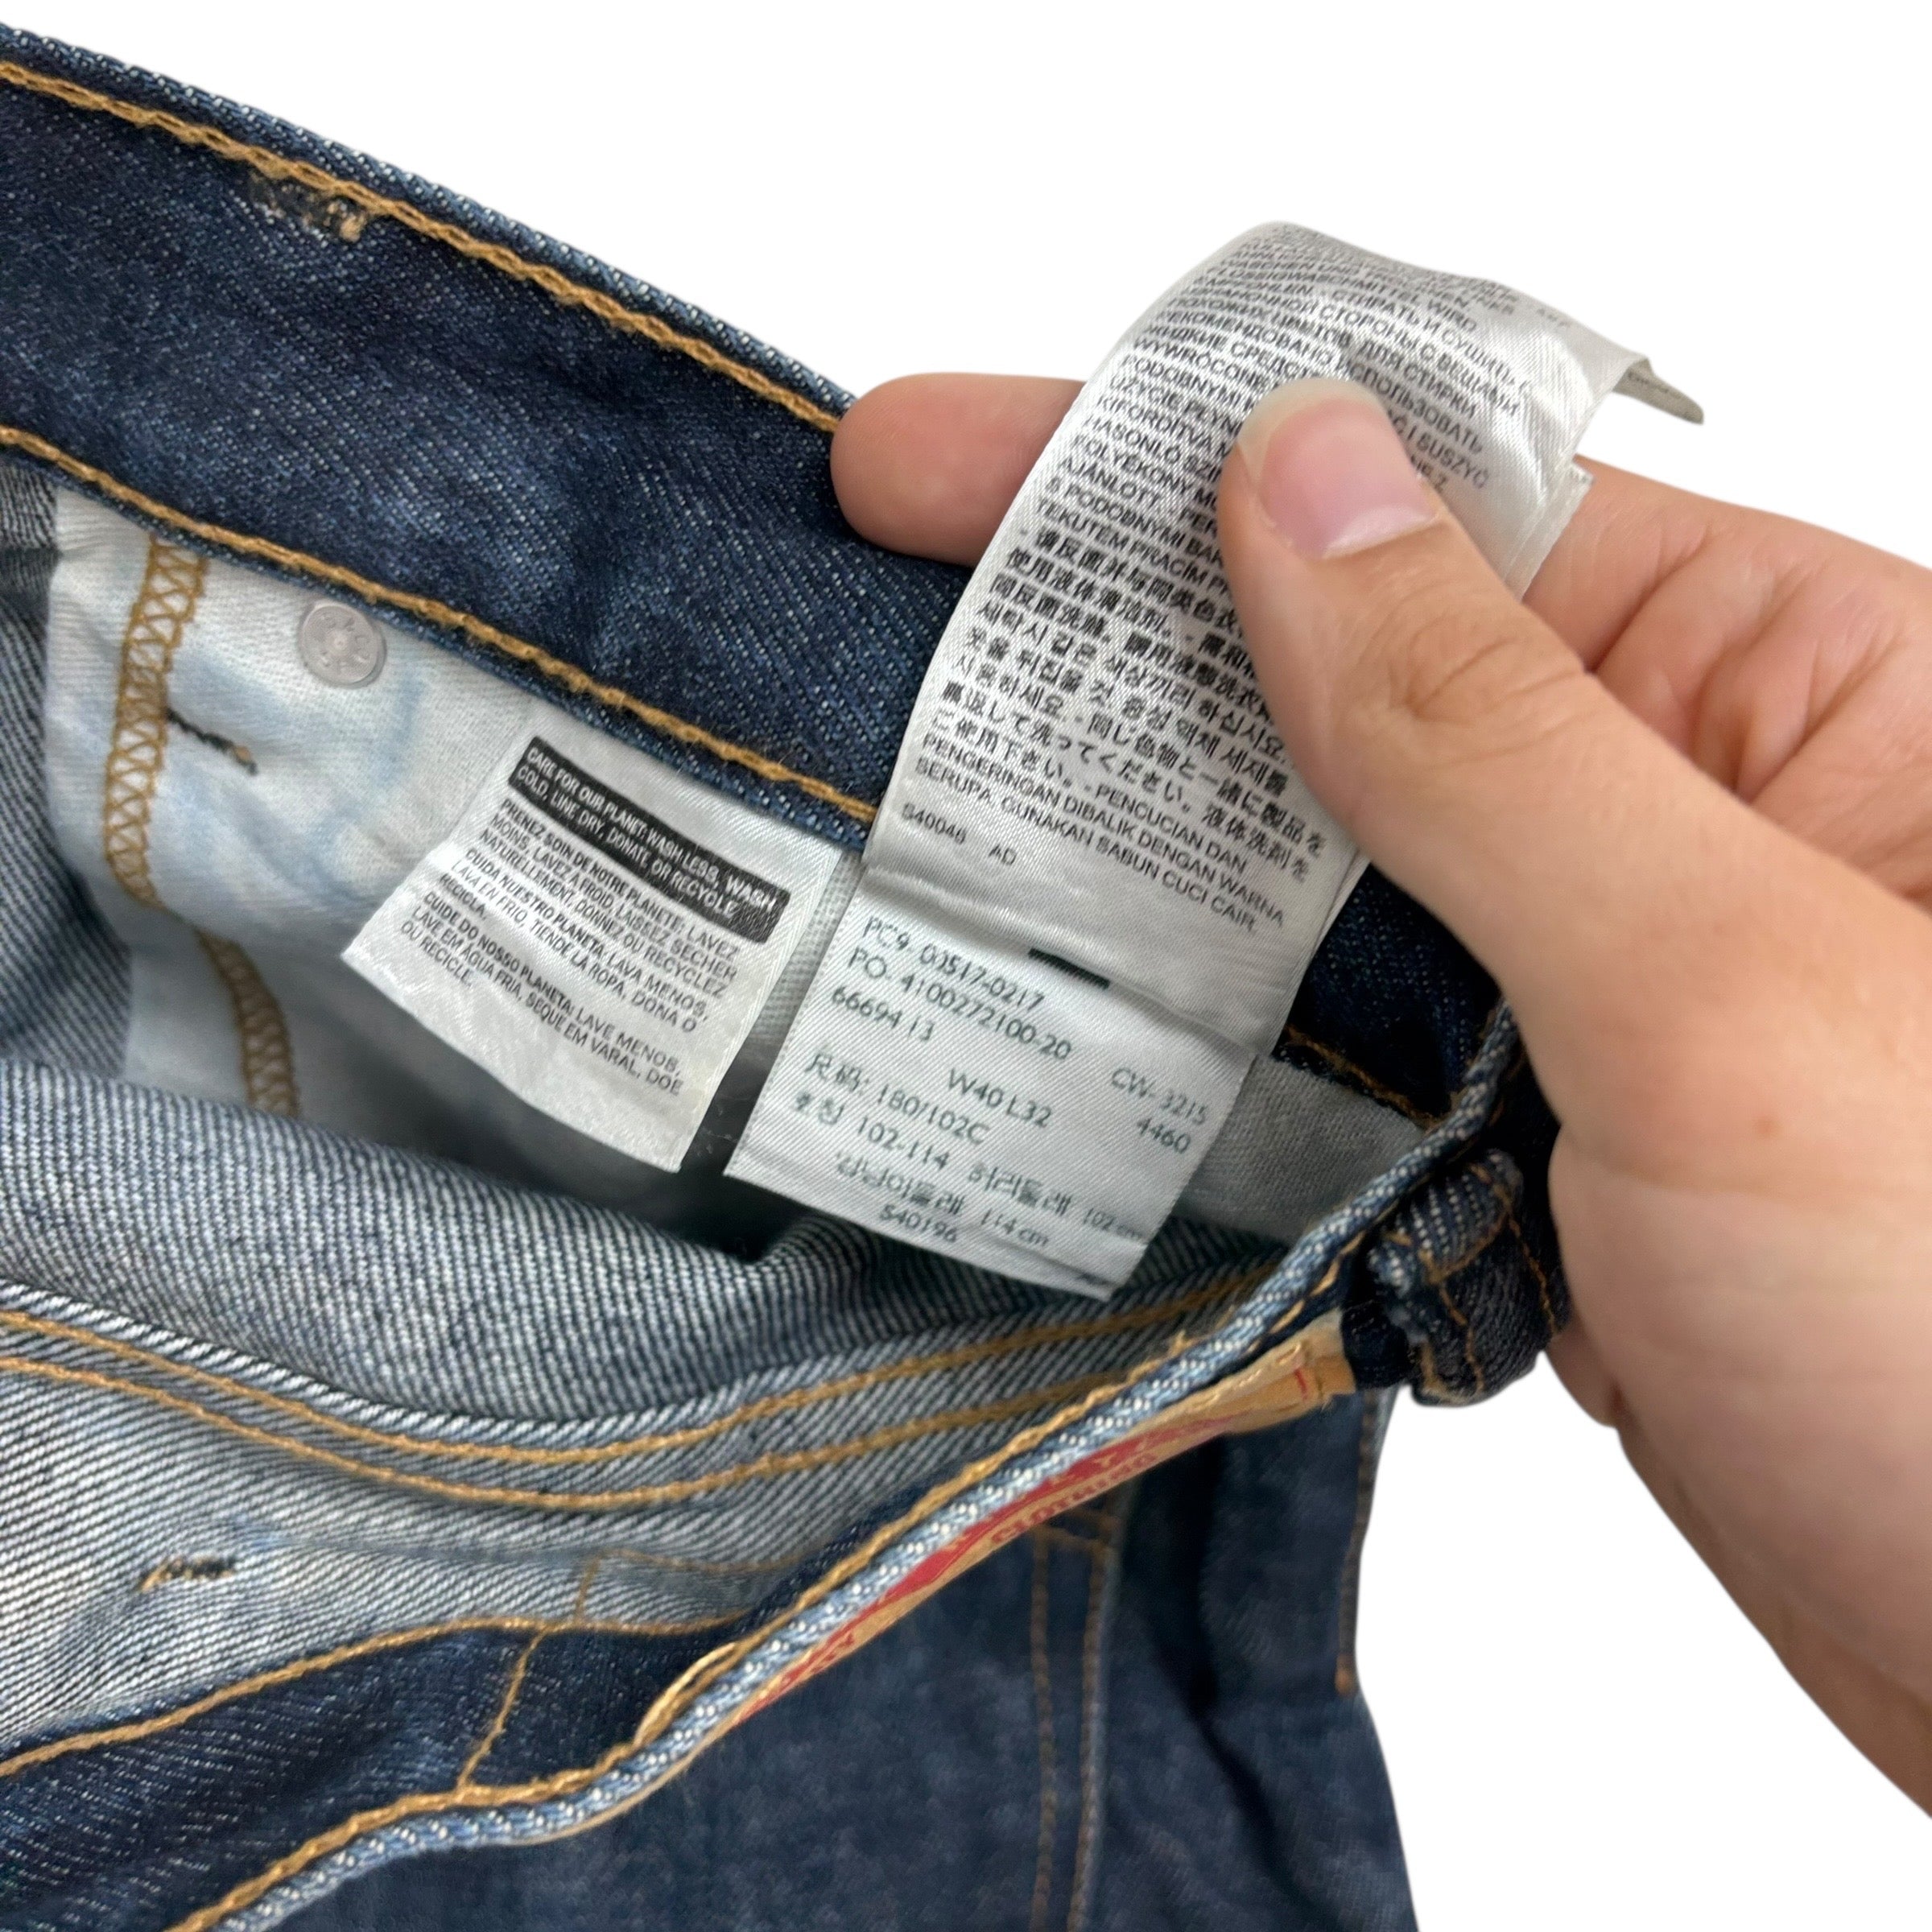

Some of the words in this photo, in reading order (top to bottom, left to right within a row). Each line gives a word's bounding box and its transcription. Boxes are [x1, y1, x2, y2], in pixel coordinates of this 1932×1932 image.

[518, 766, 550, 802] COLD,
[550, 790, 580, 820] LINE
[577, 809, 606, 840] DRY,
[606, 826, 652, 869] DONATE
[650, 857, 672, 881] OR
[527, 747, 558, 780] CARE
[554, 767, 580, 795] FOR
[578, 785, 606, 812] OUR
[646, 828, 684, 862] WASH
[681, 852, 720, 890] LESS,
[725, 874, 778, 912] WASH
[988, 844, 1019, 866] AD
[1001, 795, 1095, 846] GUNAKAN
[1095, 834, 1161, 881] SABUN
[1162, 869, 1208, 905] CUCI
[1094, 782, 1203, 852] PENCUCIAN
[1204, 840, 1247, 874] DAN
[1137, 828, 1217, 885] DENGAN
[400, 919, 423, 941] OU
[479, 831, 576, 908] NATURELLEMENT,
[574, 898, 625, 942] DONNEZ
[623, 932, 645, 955] OU
[489, 812, 531, 855] MOINS,
[533, 845, 572, 881] LAVEZ
[578, 877, 614, 914] FROID,
[613, 904, 671, 947] LAISSEZ
[500, 798, 547, 840] PRENEZ
[543, 832, 575, 861] SOIN
[572, 850, 591, 872] DE
[588, 861, 630, 898] NOTRE
[686, 926, 739, 961] LAVEZ
[423, 890, 461, 926] CUIDE
[457, 917, 480, 940] DO
[477, 934, 521, 973] NOSSO
[575, 1008, 616, 1041] LAVE
[616, 1031, 681, 1078] MENOS,
[451, 860, 481, 889] LAVA
[478, 881, 500, 902] EN
[530, 918, 576, 958] TIENDE
[570, 951, 589, 972] LA
[588, 964, 626, 1001] ROPA,
[630, 989, 678, 1027] DONA
[681, 1016, 697, 1033] O
[465, 847, 502, 881] CUIDA
[498, 874, 555, 921] NUESTRO
[607, 952, 642, 985] LAVA
[643, 973, 708, 1022] MENOS,
[412, 905, 444, 938] LAVE
[440, 927, 464, 951] EM
[493, 968, 522, 1002] FRIA,
[526, 991, 567, 1033] SEQUE
[564, 1022, 588, 1047] EM
[591, 1038, 642, 1079] VARAL,
[645, 1067, 685, 1097] DOE
[901, 971, 1072, 1060] 4100272100-20
[857, 1115, 951, 1170] 102-114
[877, 1084, 991, 1145] 180/102C
[947, 1067, 1006, 1109] W40
[1005, 1094, 1052, 1128] L32
[1136, 1117, 1192, 1154] 4460
[979, 1208, 1019, 1235] 114
[1017, 1228, 1050, 1248] cm
